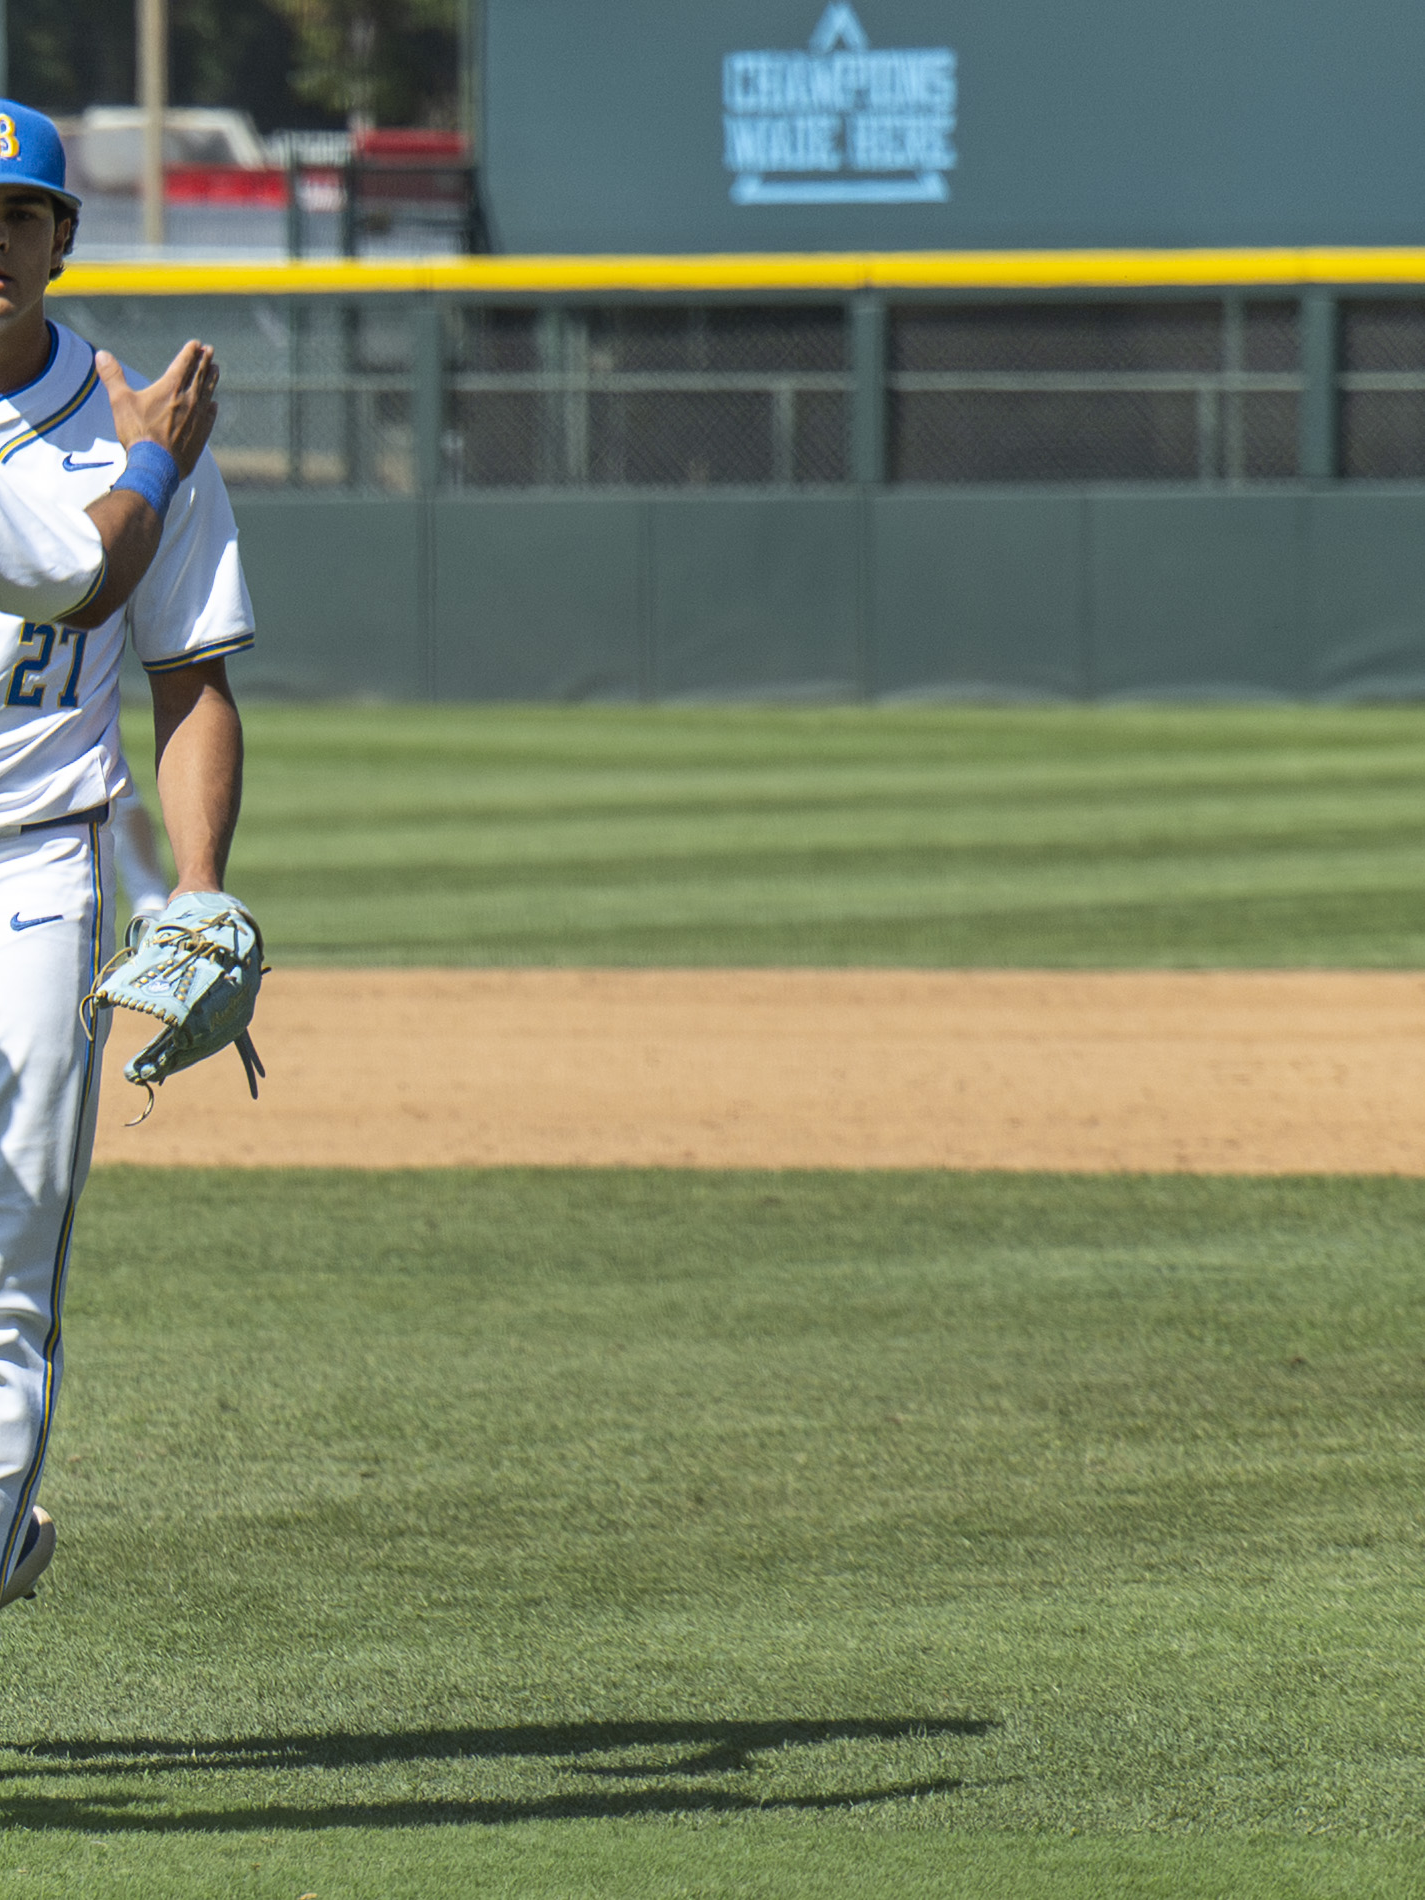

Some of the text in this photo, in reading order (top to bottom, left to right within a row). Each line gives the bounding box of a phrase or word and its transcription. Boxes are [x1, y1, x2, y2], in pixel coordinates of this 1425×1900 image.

[723, 48, 957, 112] CHAMPIONS
[723, 113, 957, 171] MADE HERE
[5, 620, 87, 708] 27
